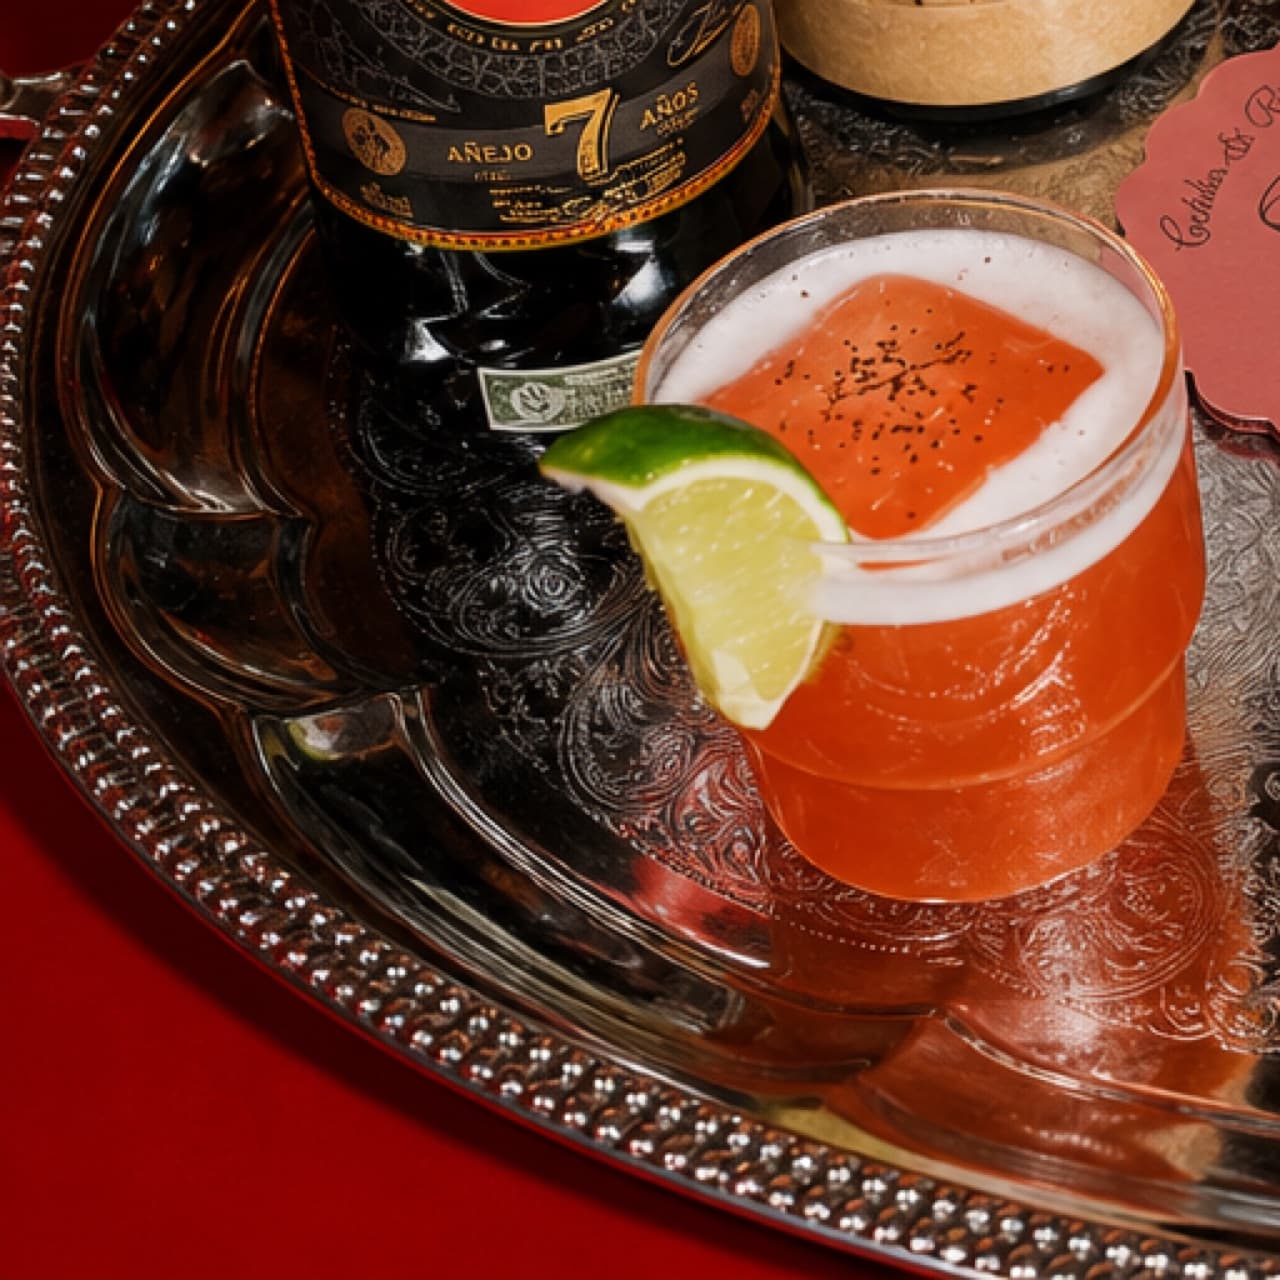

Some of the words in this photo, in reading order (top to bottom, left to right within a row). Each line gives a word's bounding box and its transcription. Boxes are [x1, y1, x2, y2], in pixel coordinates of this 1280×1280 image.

[640, 81, 699, 132] AÑOS
[447, 140, 534, 165] AÑEJO
[544, 87, 621, 187] 7
